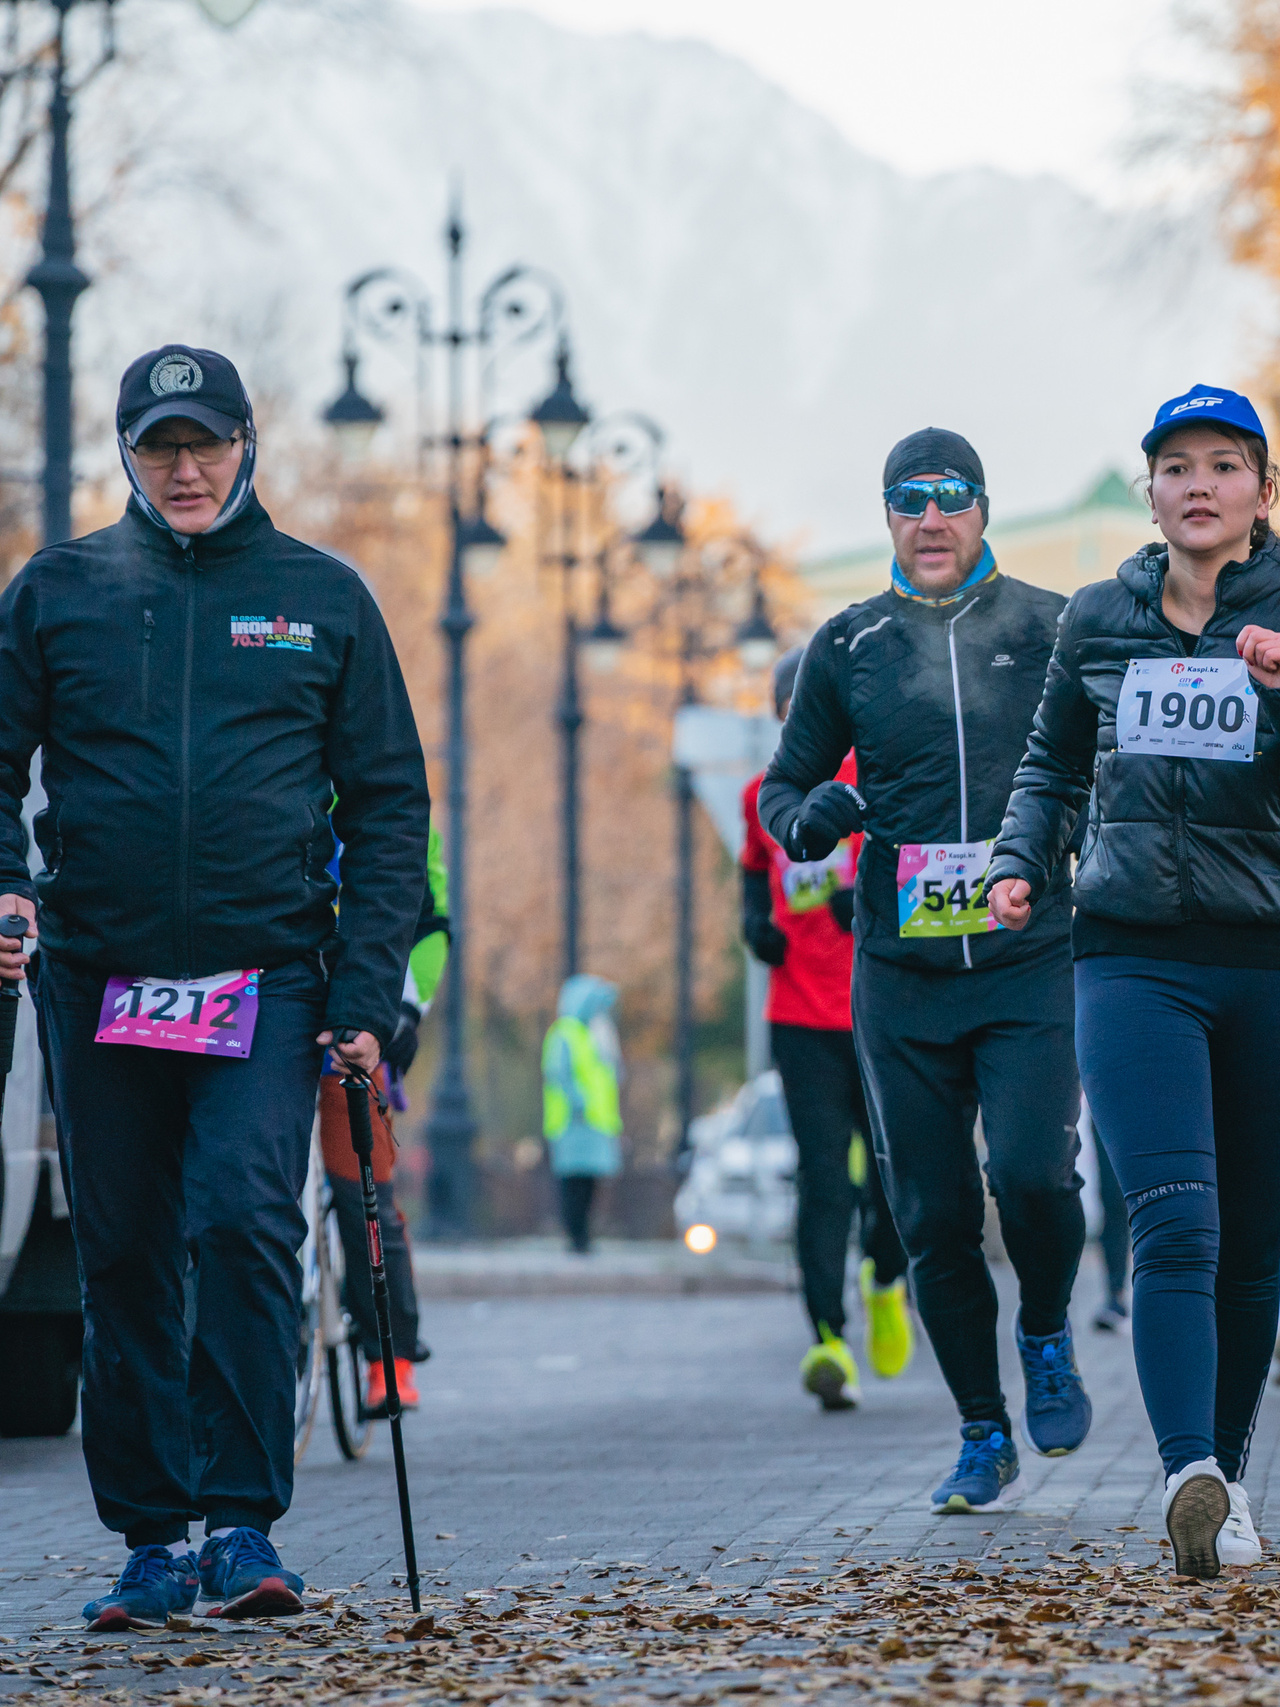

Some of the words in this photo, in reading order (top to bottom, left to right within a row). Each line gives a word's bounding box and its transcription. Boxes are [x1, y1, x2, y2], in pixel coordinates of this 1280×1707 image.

[231, 621, 314, 638] IRONMAN
[266, 634, 312, 644] ASTANA
[231, 634, 265, 647] 70.3
[1136, 690, 1245, 733] 1900
[127, 985, 240, 1030] 1212
[1137, 1182, 1205, 1205] SPORTLINE
